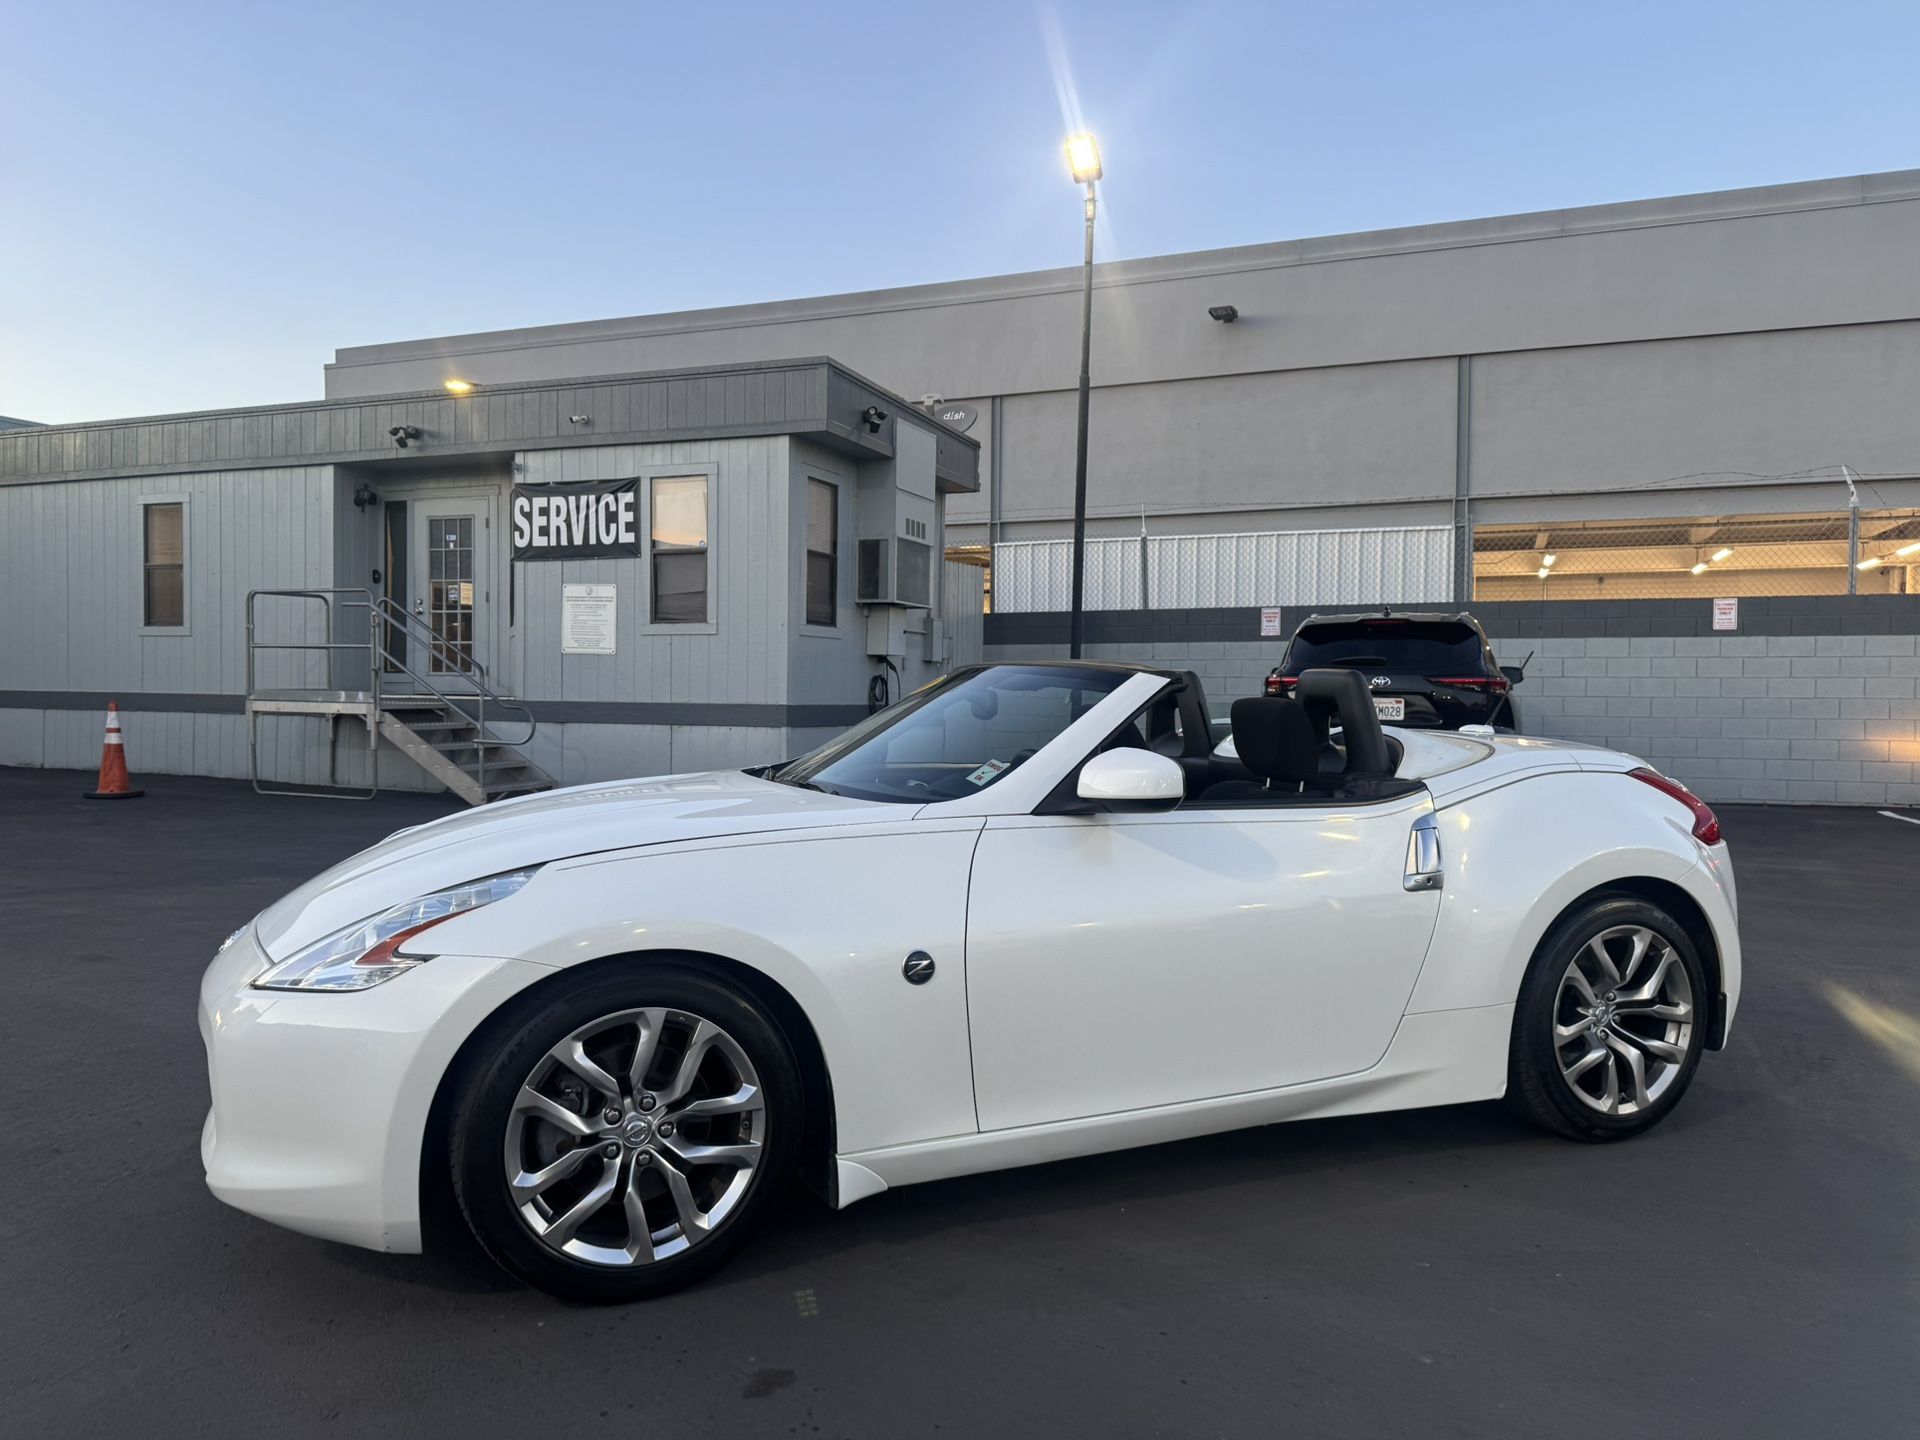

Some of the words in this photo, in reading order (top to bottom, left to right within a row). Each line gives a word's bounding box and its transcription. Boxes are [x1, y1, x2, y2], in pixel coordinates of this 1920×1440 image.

[943, 411, 965, 420] dish
[514, 492, 635, 548] SERVICE
[1375, 706, 1401, 718] M028
[986, 761, 1004, 772] SMOG
